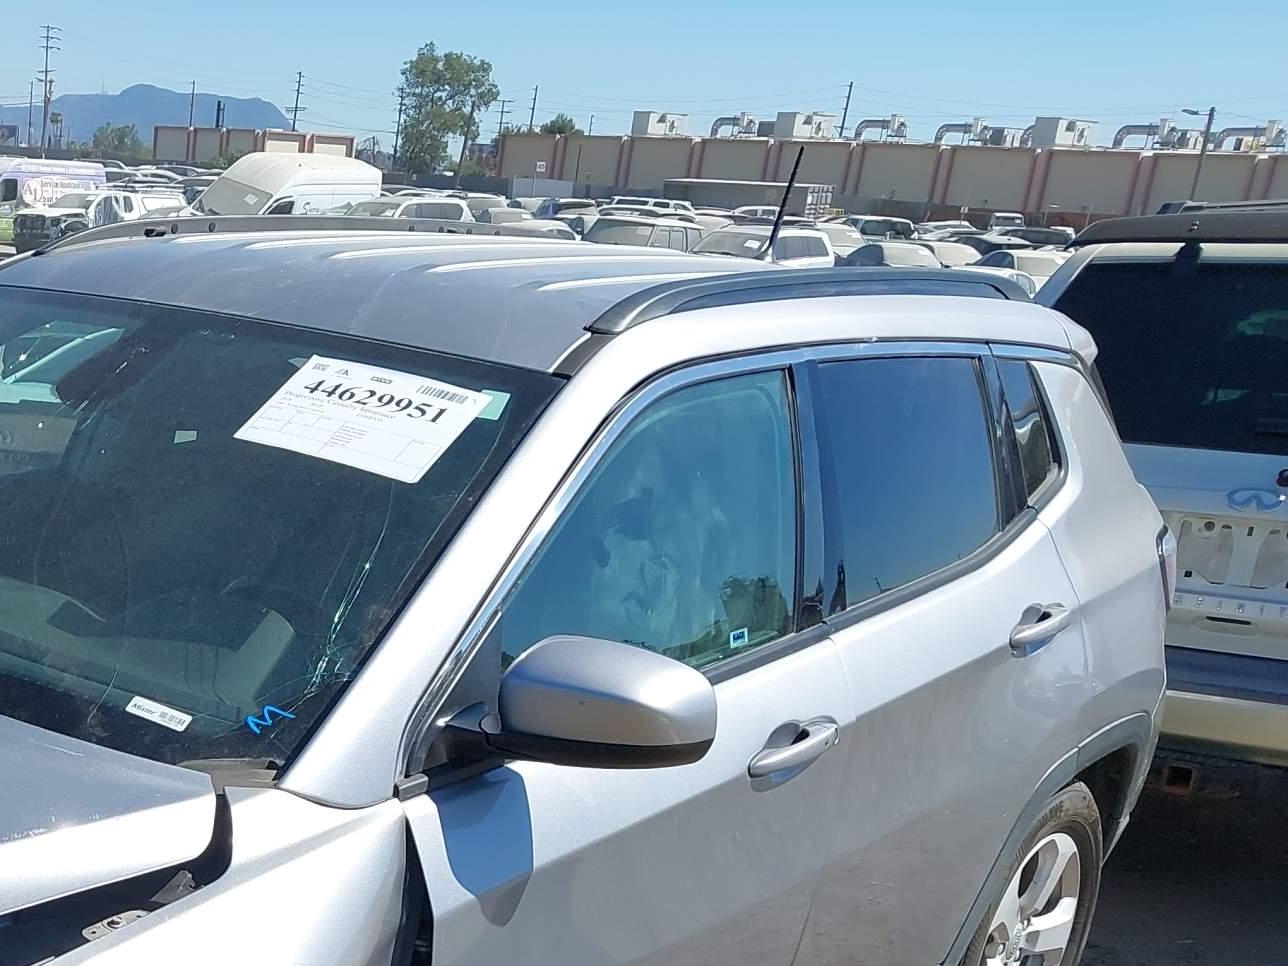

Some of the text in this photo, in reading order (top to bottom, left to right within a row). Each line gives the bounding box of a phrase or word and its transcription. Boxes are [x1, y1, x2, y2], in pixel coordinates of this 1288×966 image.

[303, 379, 448, 424] 44629951
[131, 703, 158, 715] Mister
[246, 705, 296, 734] M
